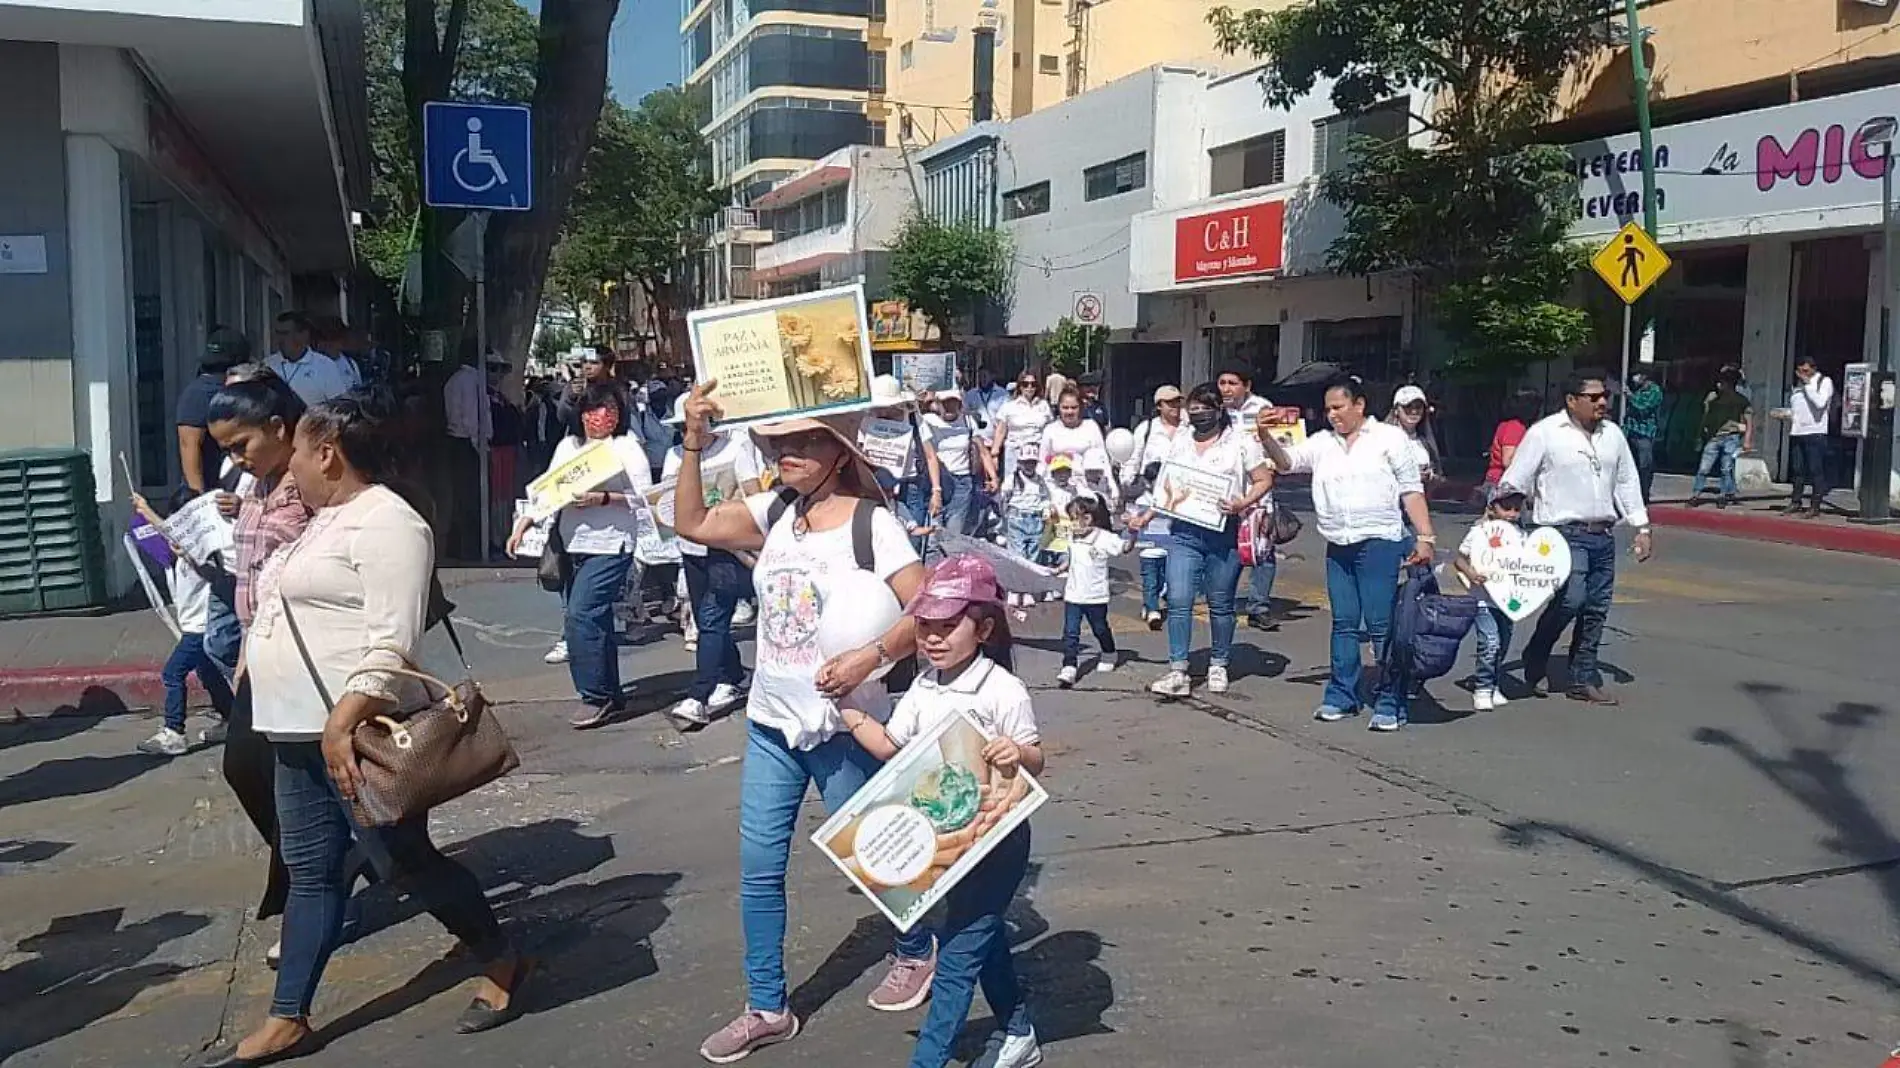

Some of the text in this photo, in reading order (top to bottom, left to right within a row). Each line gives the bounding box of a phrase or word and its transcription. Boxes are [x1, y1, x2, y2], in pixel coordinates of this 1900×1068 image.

[1204, 215, 1249, 252] C&H
[724, 330, 748, 343] PAZ
[1497, 557, 1555, 574] Violencia
[1508, 573, 1561, 589] Ternura
